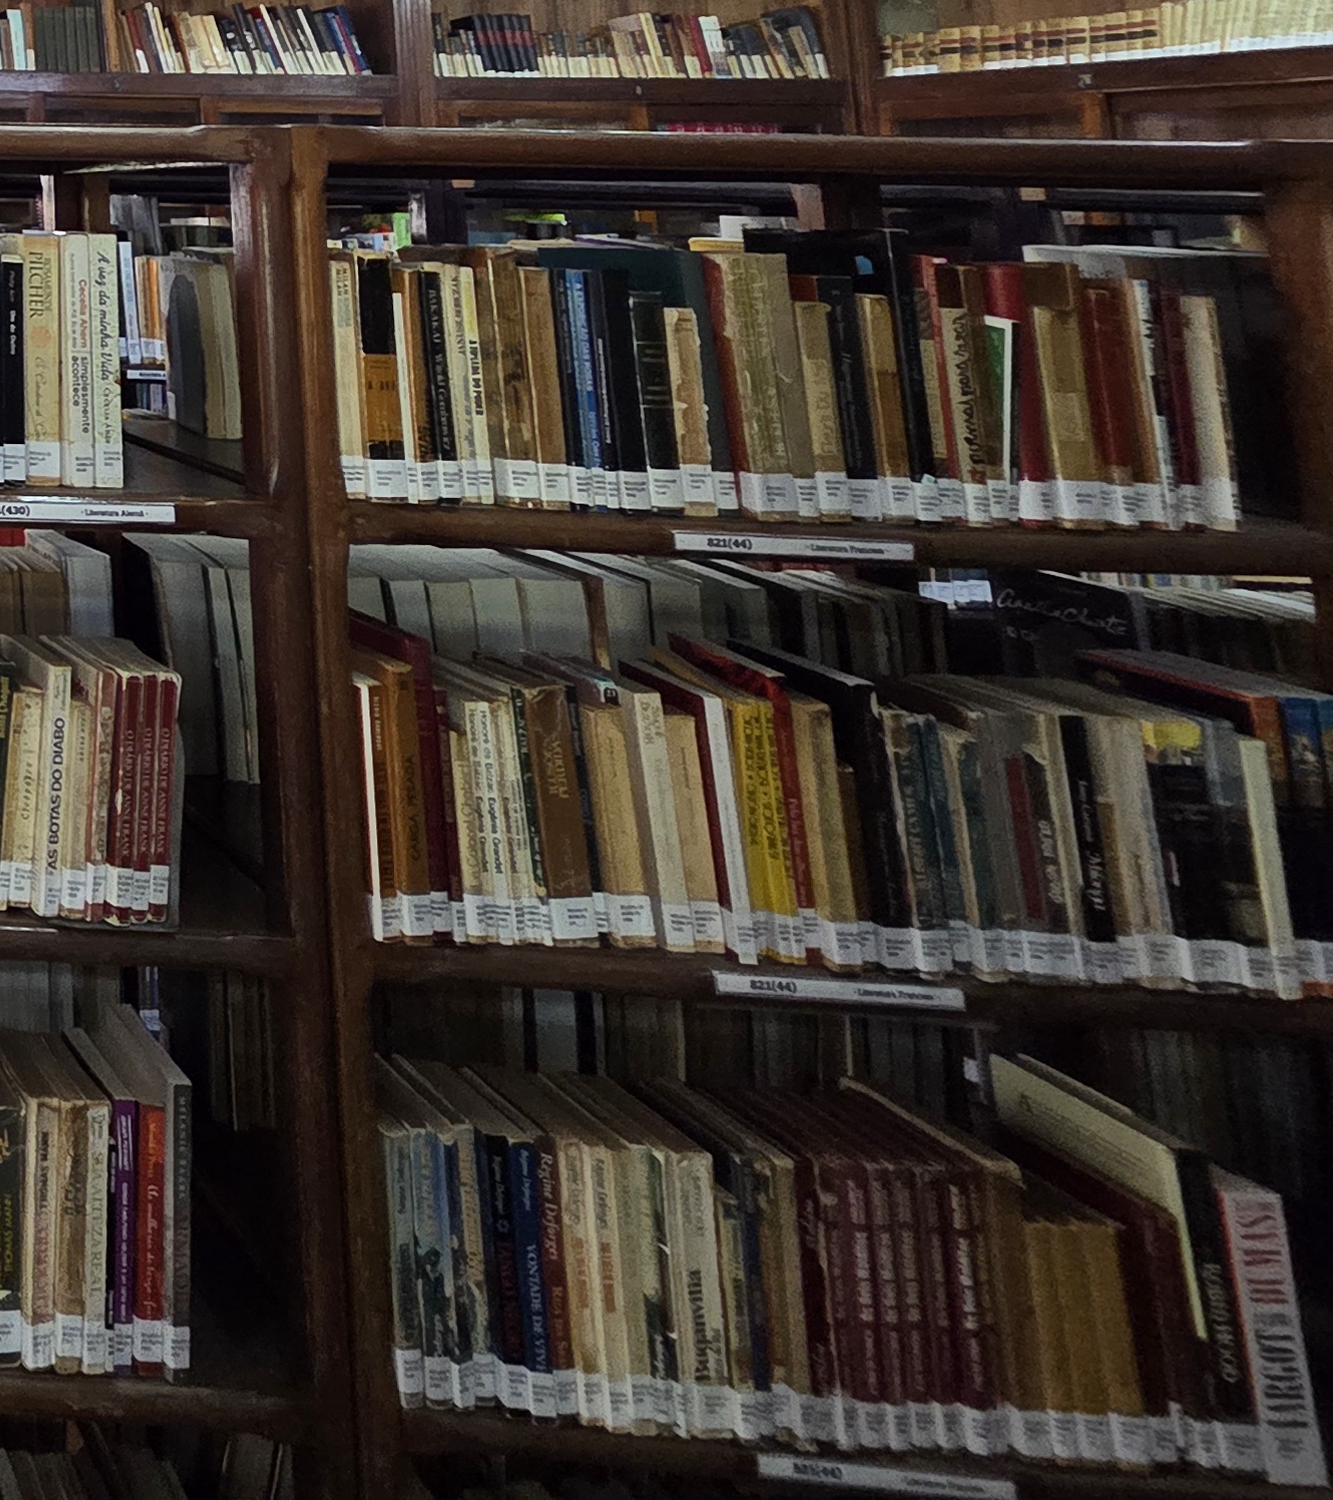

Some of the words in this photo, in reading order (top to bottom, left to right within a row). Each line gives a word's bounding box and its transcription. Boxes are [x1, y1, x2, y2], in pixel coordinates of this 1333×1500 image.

[28, 251, 44, 319] PILCHER
[43, 257, 53, 312] ROSAMUNDE
[94, 267, 107, 286] vez
[78, 279, 88, 316] Cecelia
[98, 291, 109, 306] da
[79, 318, 89, 348] Ahern
[99, 309, 112, 348] minha
[71, 355, 81, 407] acontece
[100, 352, 113, 381] Vida
[79, 356, 91, 433] simplesmente
[707, 537, 752, 551] 821(44)
[51, 717, 66, 765] DIABO
[123, 741, 135, 773] DIÁRIO
[142, 739, 154, 772] DIÁRIO
[159, 740, 170, 773] DIÁRIO
[50, 768, 63, 792] DO
[47, 794, 62, 845] BOTAS
[121, 793, 132, 822] ANNE
[141, 789, 151, 819] ANNE
[157, 790, 168, 819] ANNE
[121, 823, 131, 858] FRANK
[140, 820, 149, 854] FRANK
[156, 820, 166, 855] FRANK
[486, 797, 500, 834] Eugénie
[493, 838, 504, 874] Grandet
[46, 847, 59, 870] AS
[750, 979, 797, 994] 821(44)
[542, 1202, 560, 1261] Deforges
[525, 1244, 543, 1313] VONTADE
[532, 1316, 544, 1336] DE
